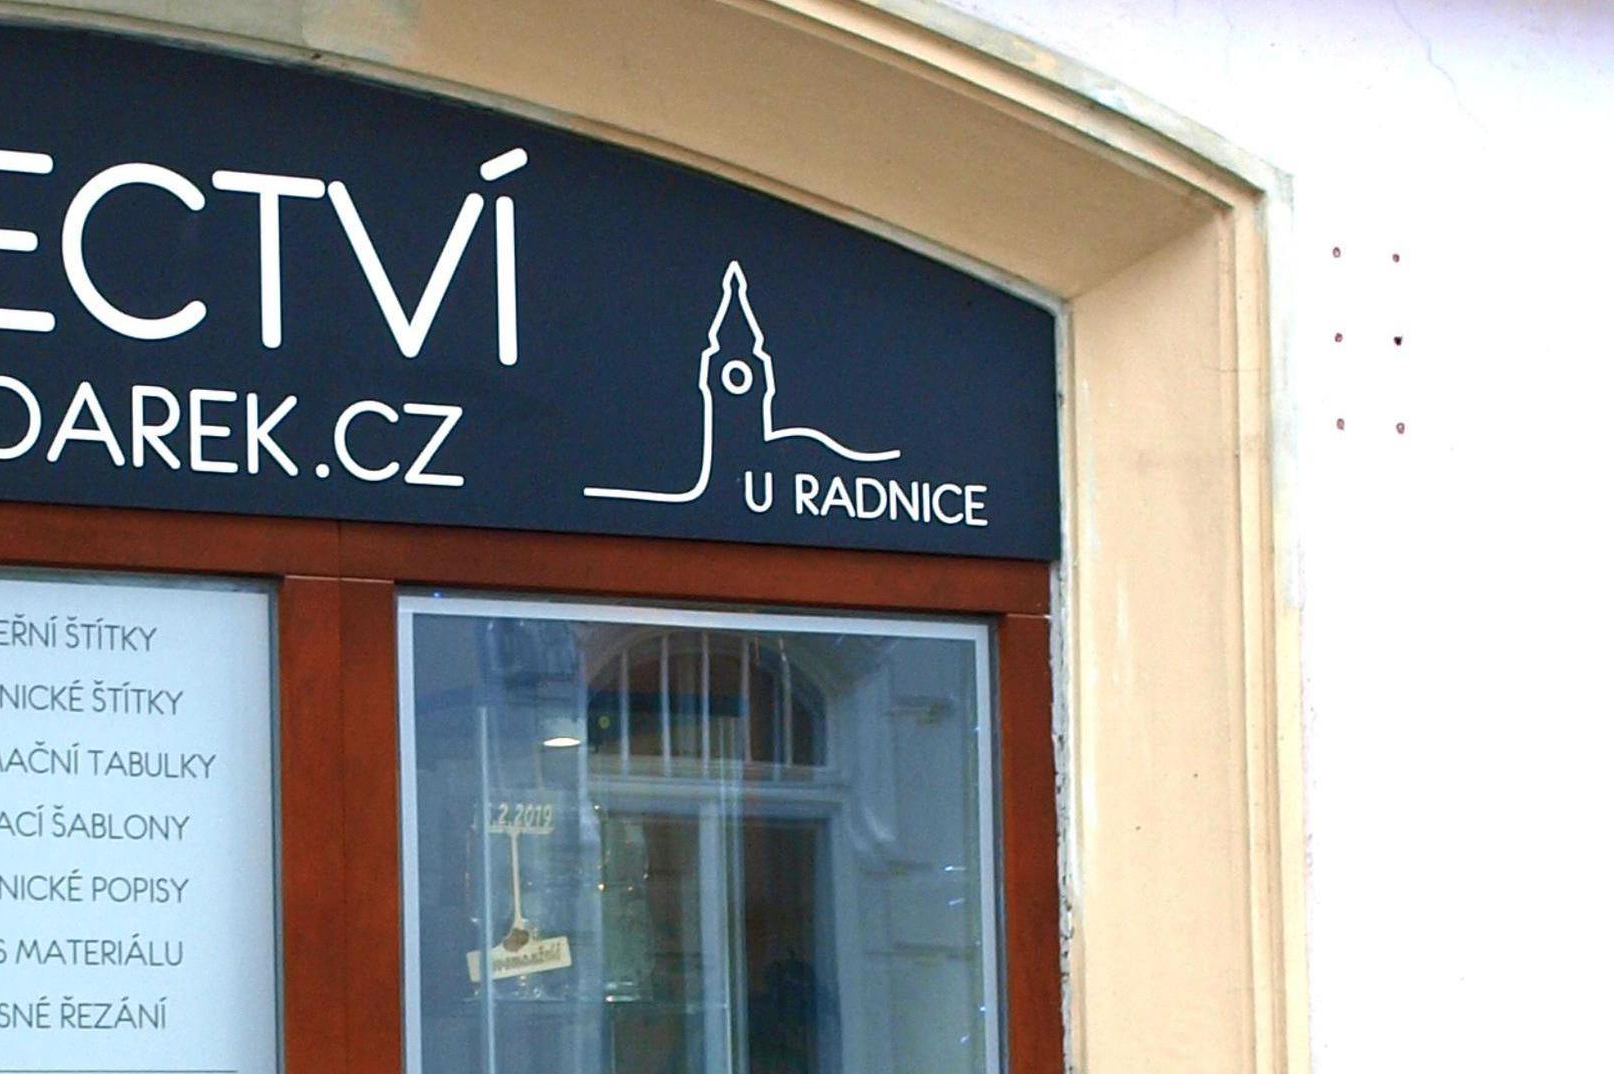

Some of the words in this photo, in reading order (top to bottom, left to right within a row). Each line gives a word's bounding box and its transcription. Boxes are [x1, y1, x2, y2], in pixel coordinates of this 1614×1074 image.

[744, 470, 774, 515] U
[795, 475, 988, 527] RADNICE
[65, 616, 157, 652] ŠTÍTKY
[92, 680, 183, 715] ŠTÍTKY
[88, 750, 216, 779] TABULKY
[52, 806, 190, 840] ŠABLONY
[92, 876, 189, 903] POPISY
[16, 934, 183, 966] MATERIÁLU
[61, 997, 167, 1029] ŘEZÁNÍ
